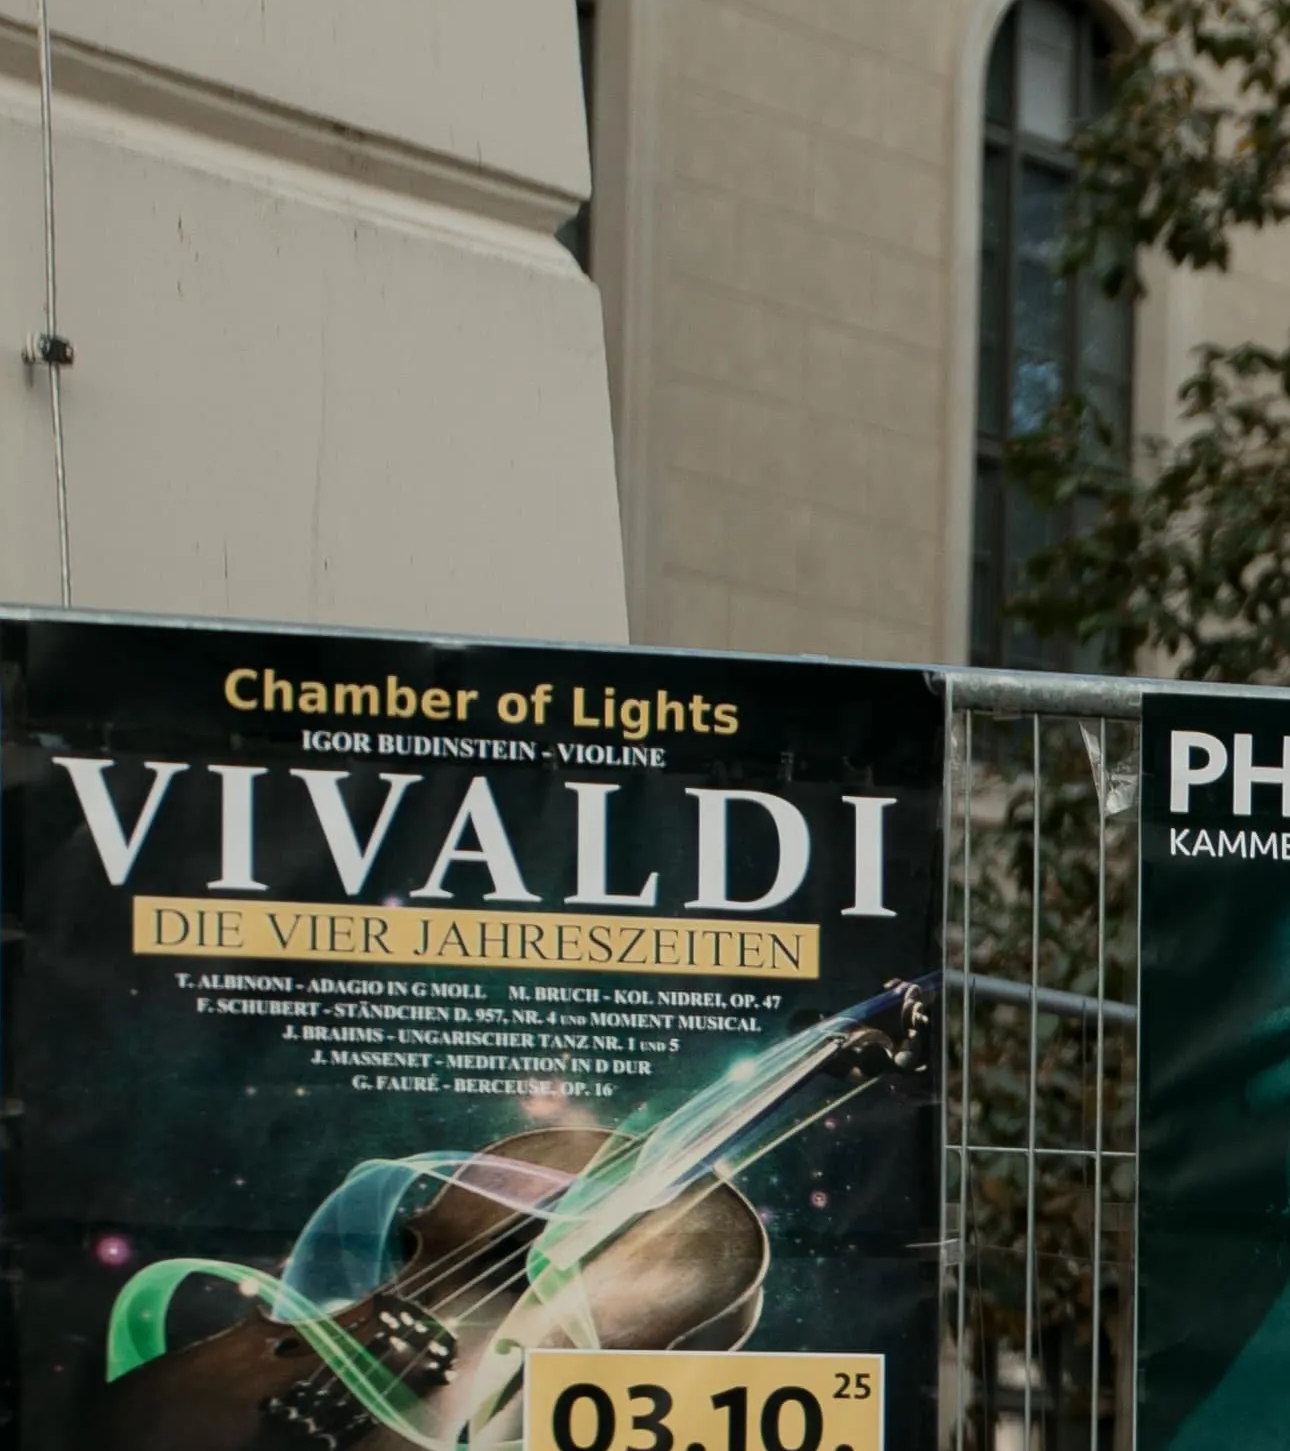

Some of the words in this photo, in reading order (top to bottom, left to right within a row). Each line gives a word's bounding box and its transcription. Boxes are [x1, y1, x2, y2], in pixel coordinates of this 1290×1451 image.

[224, 668, 479, 720] Chamber
[497, 683, 553, 725] of
[573, 687, 738, 739] Lights
[303, 730, 371, 753] IGOR
[378, 733, 536, 761] BUDINSTEIN
[557, 743, 665, 767] VIOLINE
[52, 756, 897, 917] VIVALDI
[155, 908, 243, 947] DIE
[268, 913, 393, 955] VIER
[412, 919, 804, 970] JAHRESZEITEN
[177, 973, 193, 988] T.
[201, 974, 292, 992] ALBINONI
[310, 978, 384, 995] ADAGIO
[387, 981, 408, 996] IN
[411, 982, 427, 997] G
[431, 982, 487, 999] MOLL
[509, 985, 531, 1001] M.
[534, 986, 599, 1003] BRUCH
[614, 989, 654, 1005] KOL
[657, 991, 727, 1009] NIDREI,
[729, 994, 759, 1008] OP.
[762, 995, 781, 1009] 47
[216, 999, 320, 1017] SCHUBERT
[334, 1002, 450, 1021] STÄNDCHEN
[453, 1007, 473, 1022] D.
[475, 1008, 509, 1025] 957,
[512, 1009, 544, 1025] NR.
[590, 1011, 675, 1029] MOMENT
[678, 1015, 762, 1032] MUSICAL
[282, 1025, 298, 1039] J.
[302, 1025, 384, 1043] BRAHMS
[398, 1029, 535, 1048] UNGARISCHER
[537, 1033, 589, 1050] TANZ
[592, 1035, 624, 1051] NR.
[669, 1038, 680, 1053] 5
[311, 1049, 327, 1064] J.
[331, 1050, 433, 1068] MASSENET
[446, 1054, 570, 1072] MEDITATION
[571, 1058, 591, 1073] IN
[595, 1058, 609, 1074] D
[612, 1059, 652, 1075] DUR
[352, 1075, 373, 1090] G.
[376, 1075, 439, 1092] FAURÉ
[562, 1081, 591, 1097] OP.
[595, 1082, 613, 1097] 16
